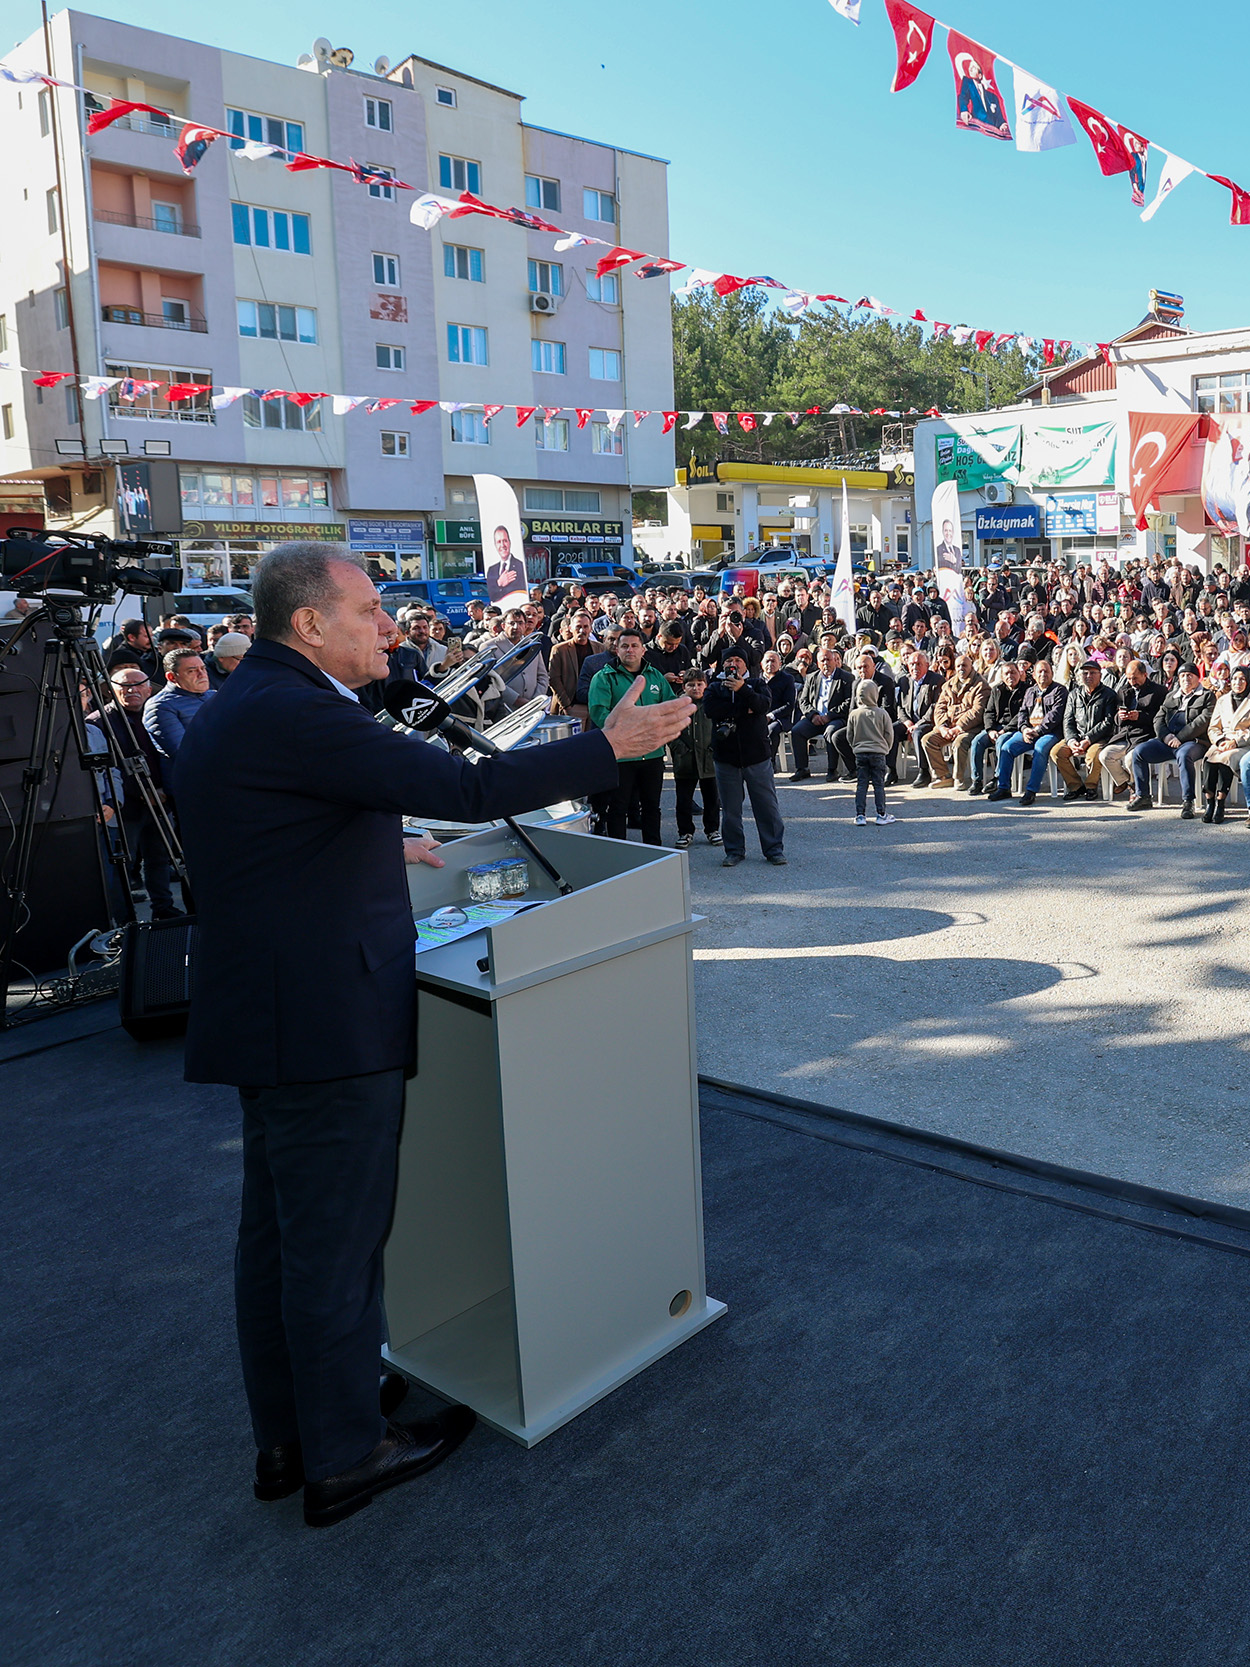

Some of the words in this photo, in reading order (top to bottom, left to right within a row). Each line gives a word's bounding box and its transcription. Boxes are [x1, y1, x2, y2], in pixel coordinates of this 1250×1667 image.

[956, 455, 973, 468] HOŞ
[531, 520, 601, 533] BAKIRLAR
[604, 523, 621, 534] ET
[977, 514, 1035, 531] Özkaymak
[213, 524, 251, 533] YILDIZ
[255, 523, 342, 536] FOTOĞRAFÇILIK
[557, 552, 585, 564] 2026
